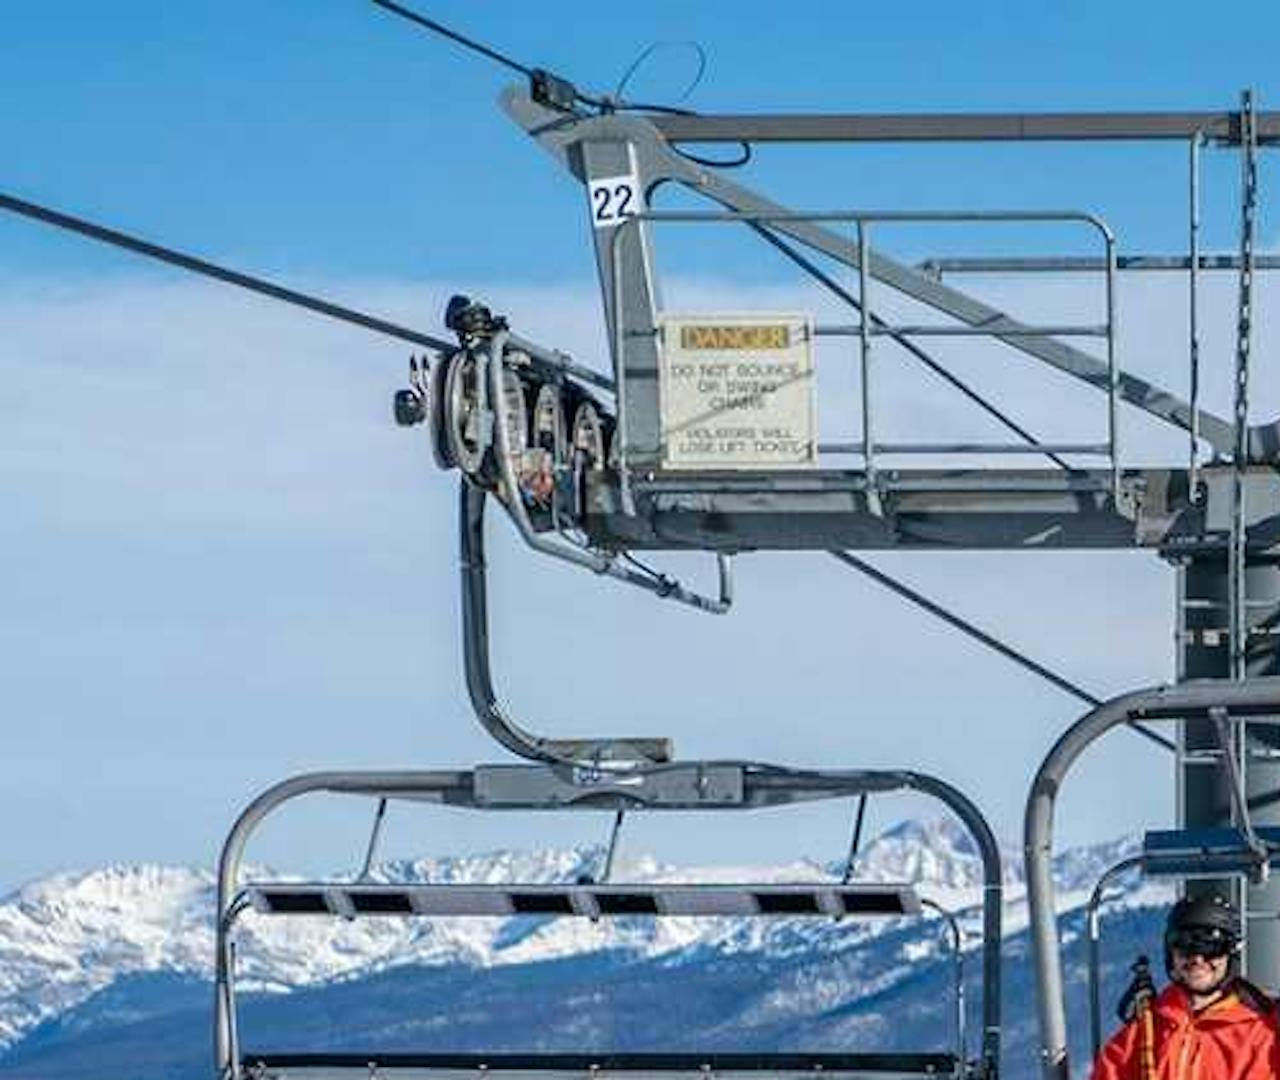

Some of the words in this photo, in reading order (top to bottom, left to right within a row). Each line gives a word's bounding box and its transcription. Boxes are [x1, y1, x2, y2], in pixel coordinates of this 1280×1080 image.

[594, 185, 635, 220] 22
[685, 327, 787, 348] DANGER
[671, 364, 694, 378] DO
[699, 364, 730, 377] NOT
[698, 380, 720, 393] OR
